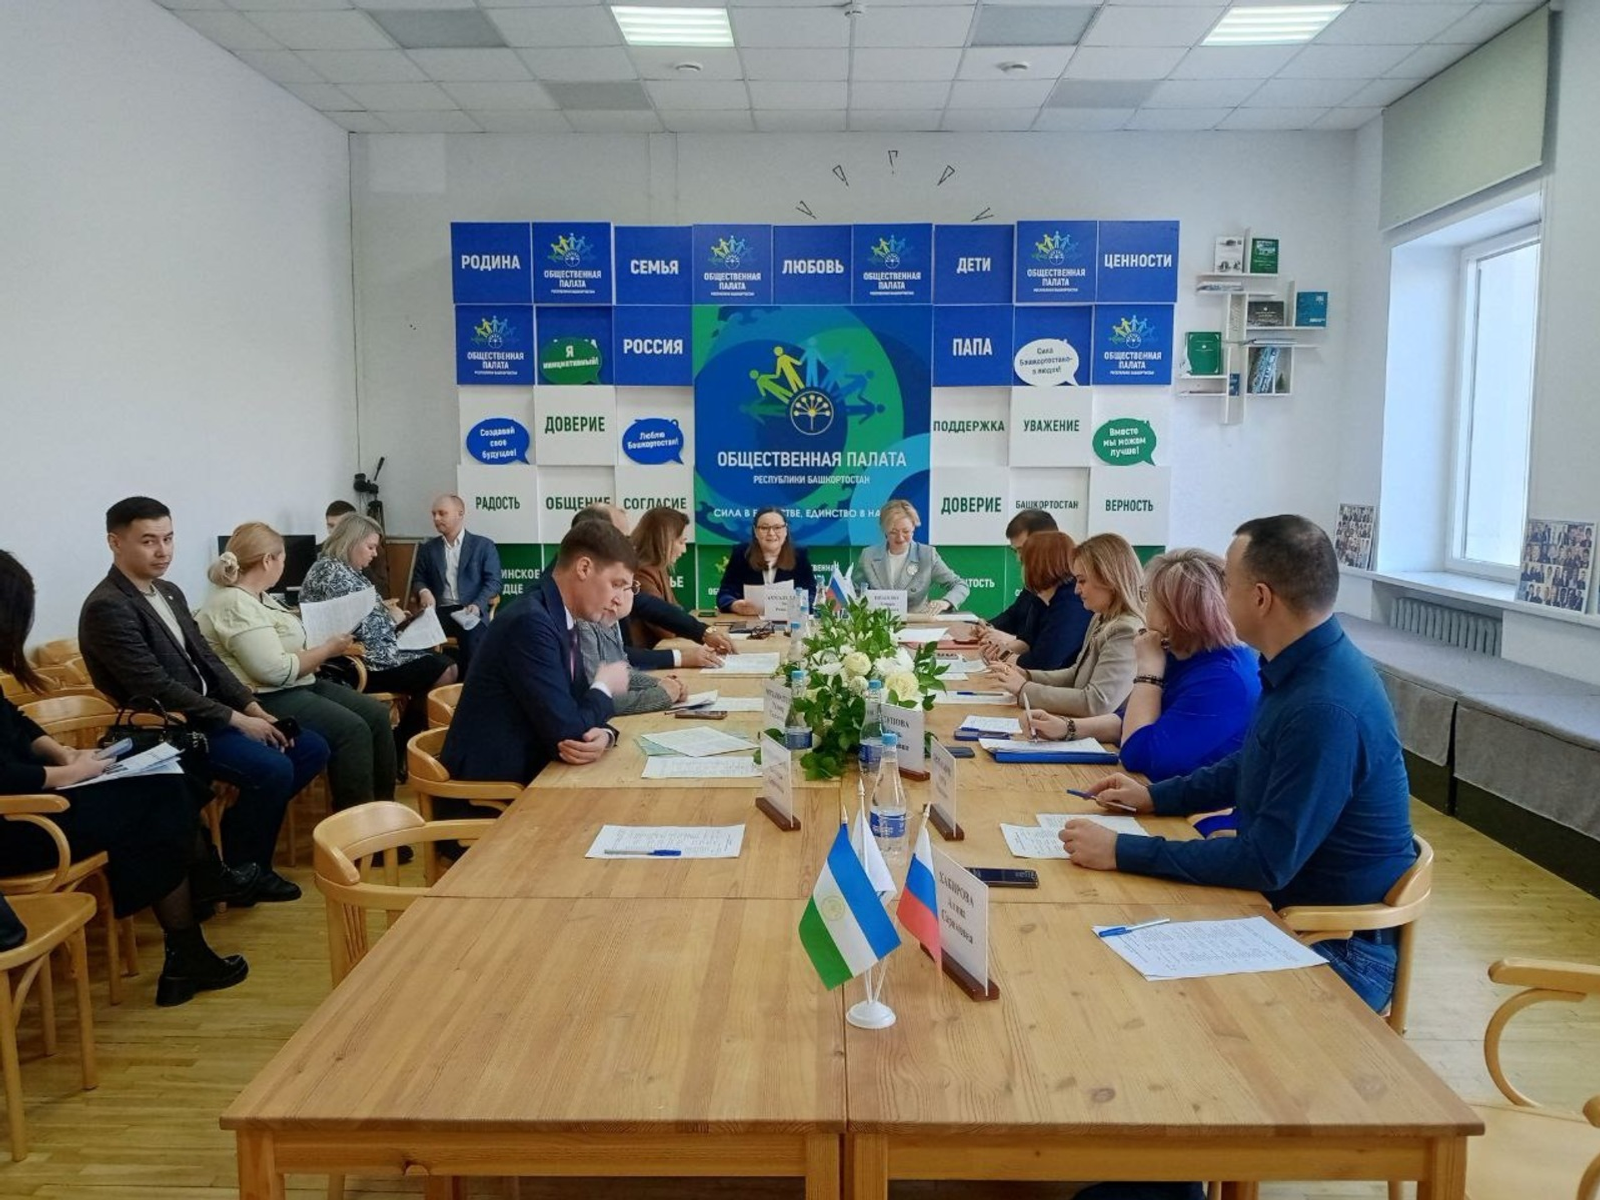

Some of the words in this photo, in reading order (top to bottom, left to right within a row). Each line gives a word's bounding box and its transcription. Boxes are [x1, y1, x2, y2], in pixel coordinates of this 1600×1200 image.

[461, 254, 521, 271] РОДИНА
[630, 259, 679, 275] СЕМЬЯ
[782, 259, 844, 275] ЛЮБОВЬ
[956, 257, 991, 274] ДЕТИ
[1104, 253, 1172, 270] ЦЕННОСТИ
[544, 270, 602, 279] ОБЩЕСТВЕННАЯ
[704, 272, 762, 281] ОБЩЕСТВЕННАЯ
[863, 271, 922, 281] ОБЩЕСТВЕННАЯ
[1027, 268, 1086, 278] ОБЩЕСТВЕННАЯ
[559, 280, 587, 288] ПАЛАТА
[719, 282, 746, 290] ПАЛАТА
[878, 281, 906, 290] ПАЛАТА
[1042, 278, 1070, 287] ПАЛАТА
[565, 345, 574, 358] Я
[623, 338, 683, 355] РОССИЯ
[952, 337, 993, 357] ПАПА
[467, 351, 525, 361] ОБЩЕСТВЕННАЯ
[1104, 351, 1162, 361] ОБЩЕСТВЕННАЯ
[482, 361, 509, 369] ПАЛАТА
[1119, 361, 1146, 370] ПАЛАТА
[544, 416, 606, 434] ДОВЕРИЕ
[933, 420, 1005, 434] ПОДДЕРЖКА
[1023, 419, 1080, 433] УВАЖЕНИЕ
[1109, 427, 1139, 437] Вместе
[1103, 439, 1117, 447] мы
[1118, 437, 1147, 446] можем
[1110, 446, 1140, 458] лучше!
[717, 451, 842, 469] ОБЩЕСТВЕННАЯ
[847, 451, 907, 467] ПАЛАТА
[753, 475, 806, 484] РЕСПУБЛИКИ
[807, 475, 871, 484] БАШКОРТОСТАН
[476, 496, 520, 510] РАДОСТЬ
[623, 497, 687, 510] СОГЛАСИЕ
[941, 497, 1002, 515] ДОВЕРИЕ
[1015, 500, 1079, 510] БАШКОРТОСТАН
[1105, 499, 1154, 512] ВЕРНОСТЬ
[713, 509, 742, 518] СИЛА
[744, 509, 750, 518] В
[805, 509, 857, 519] ЕДИНСТВО
[859, 509, 866, 518] В
[501, 568, 541, 580] ИНСКОЕ
